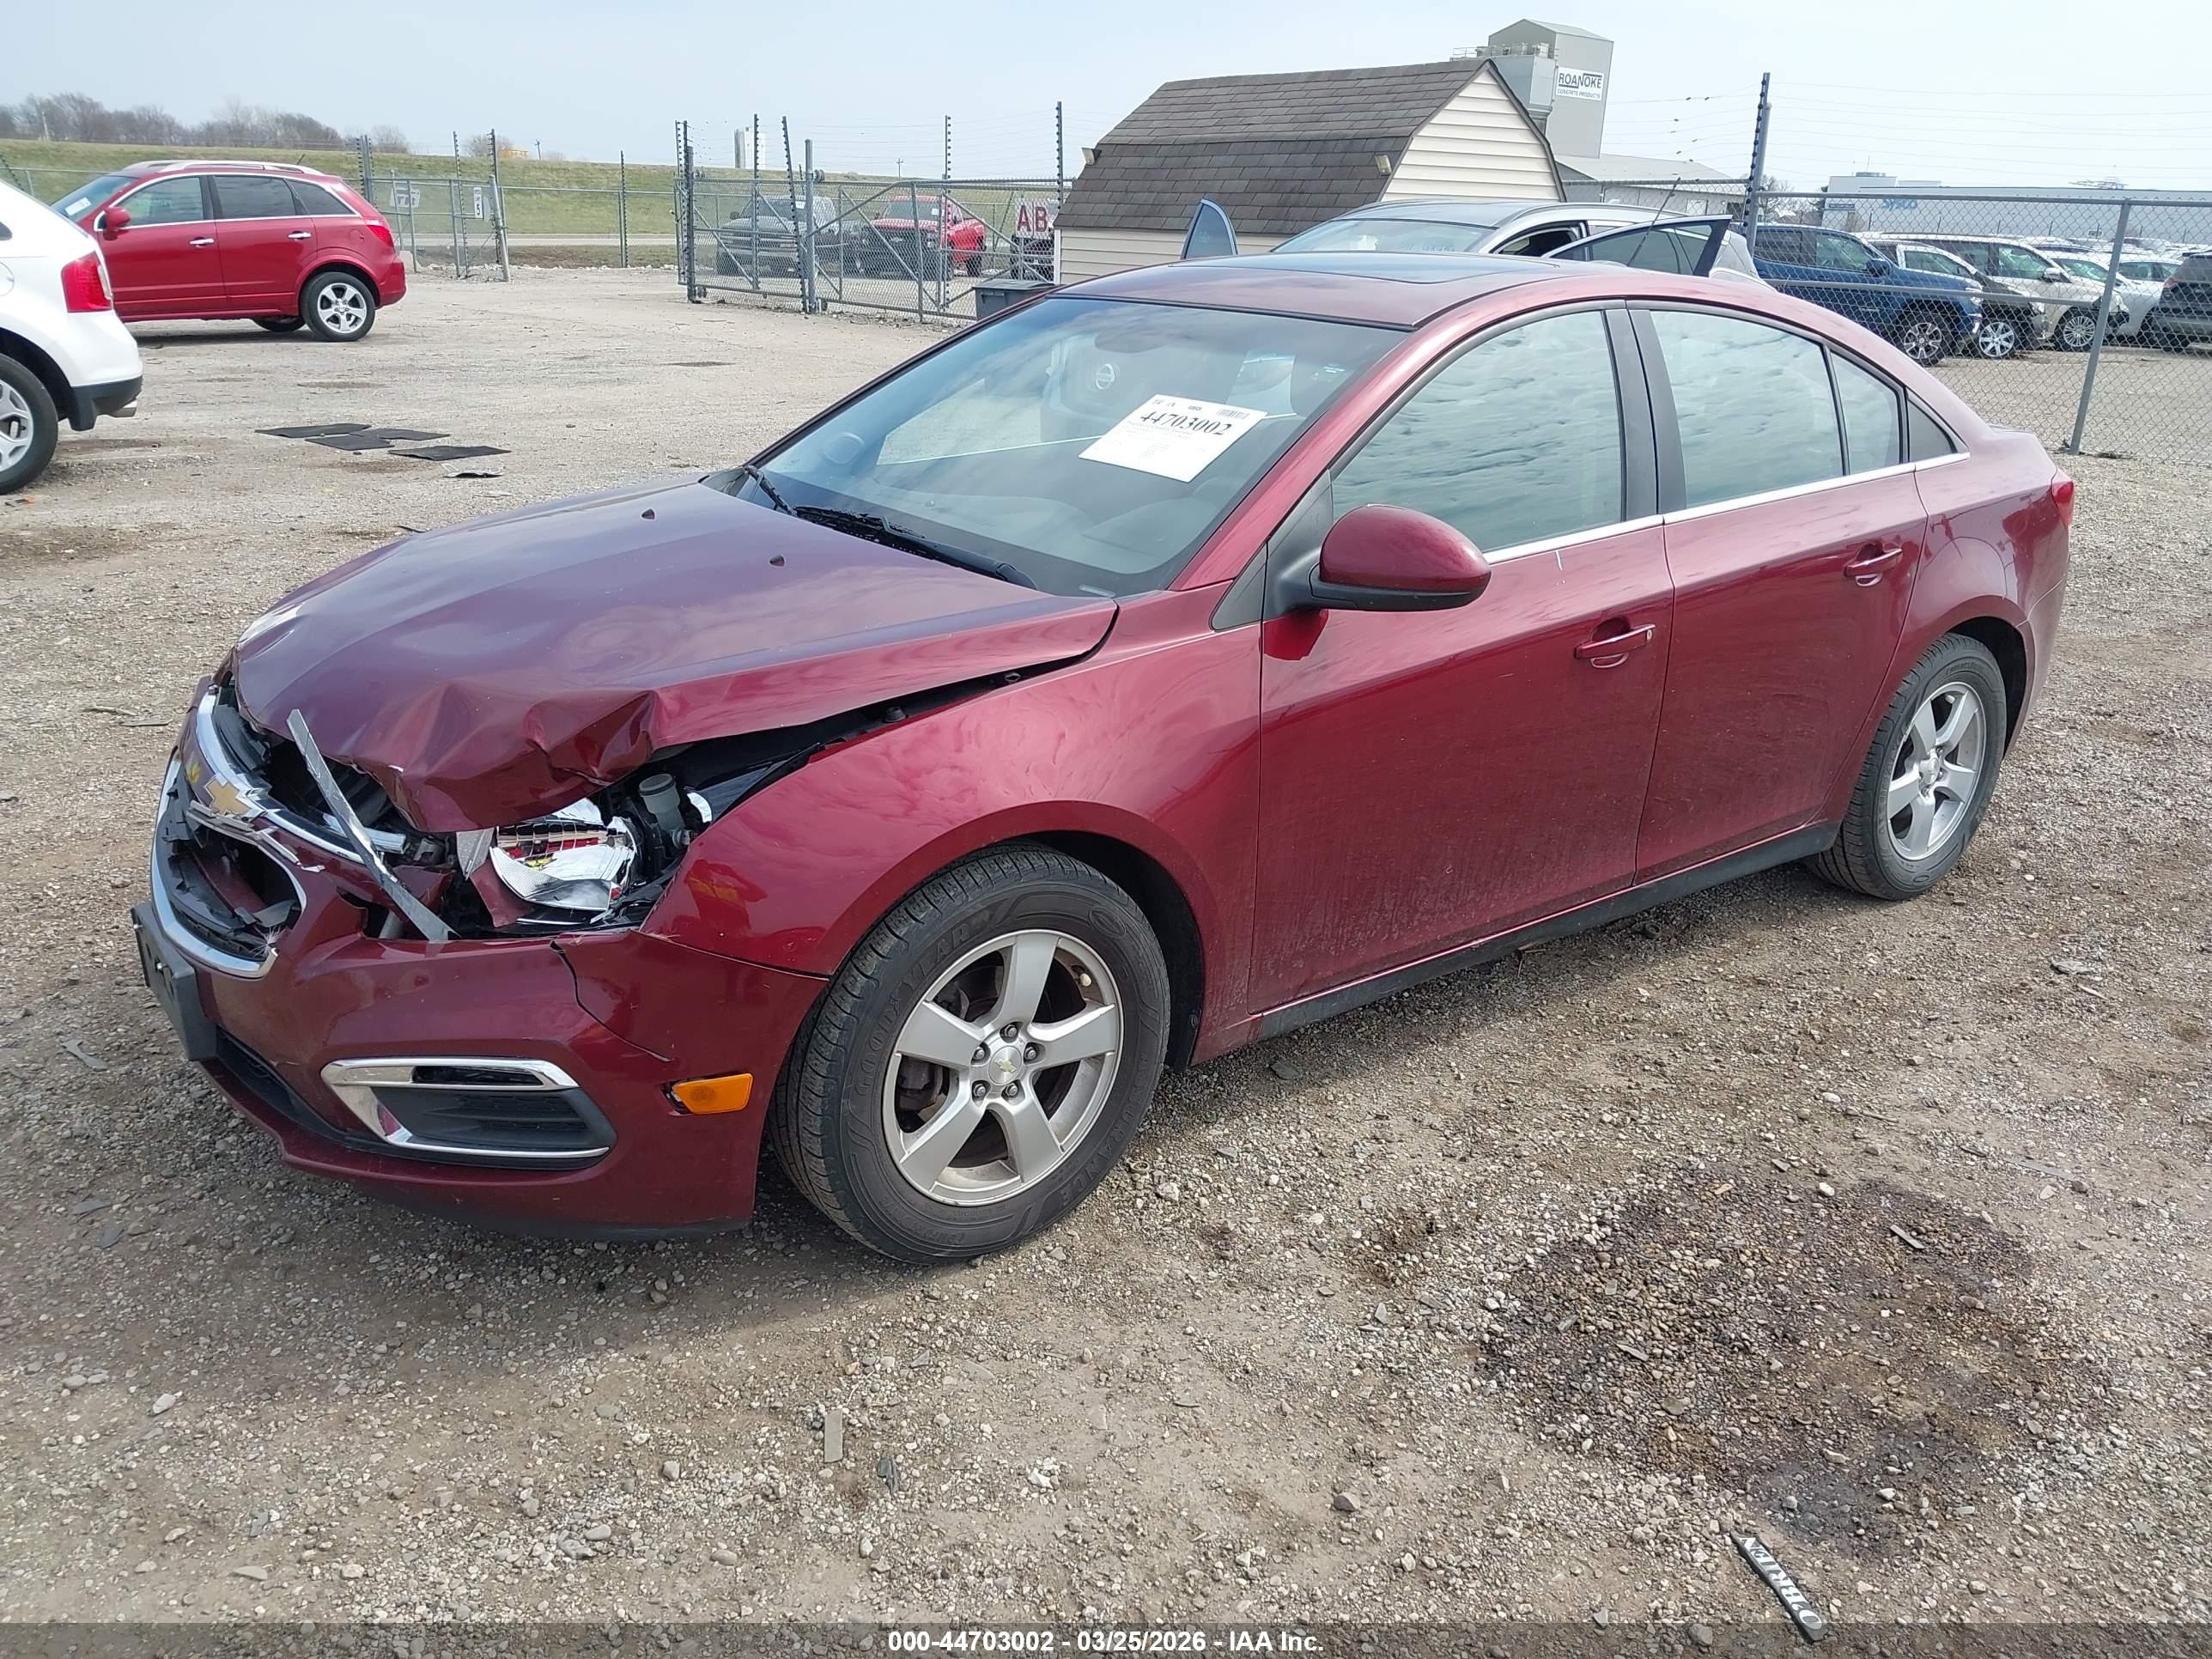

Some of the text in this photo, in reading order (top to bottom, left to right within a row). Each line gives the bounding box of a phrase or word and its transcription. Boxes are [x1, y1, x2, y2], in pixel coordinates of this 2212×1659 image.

[1559, 72, 1602, 88] ROANOKE
[1139, 410, 1233, 436] 44703002
[1738, 1537, 1823, 1630] O'BRIEN
